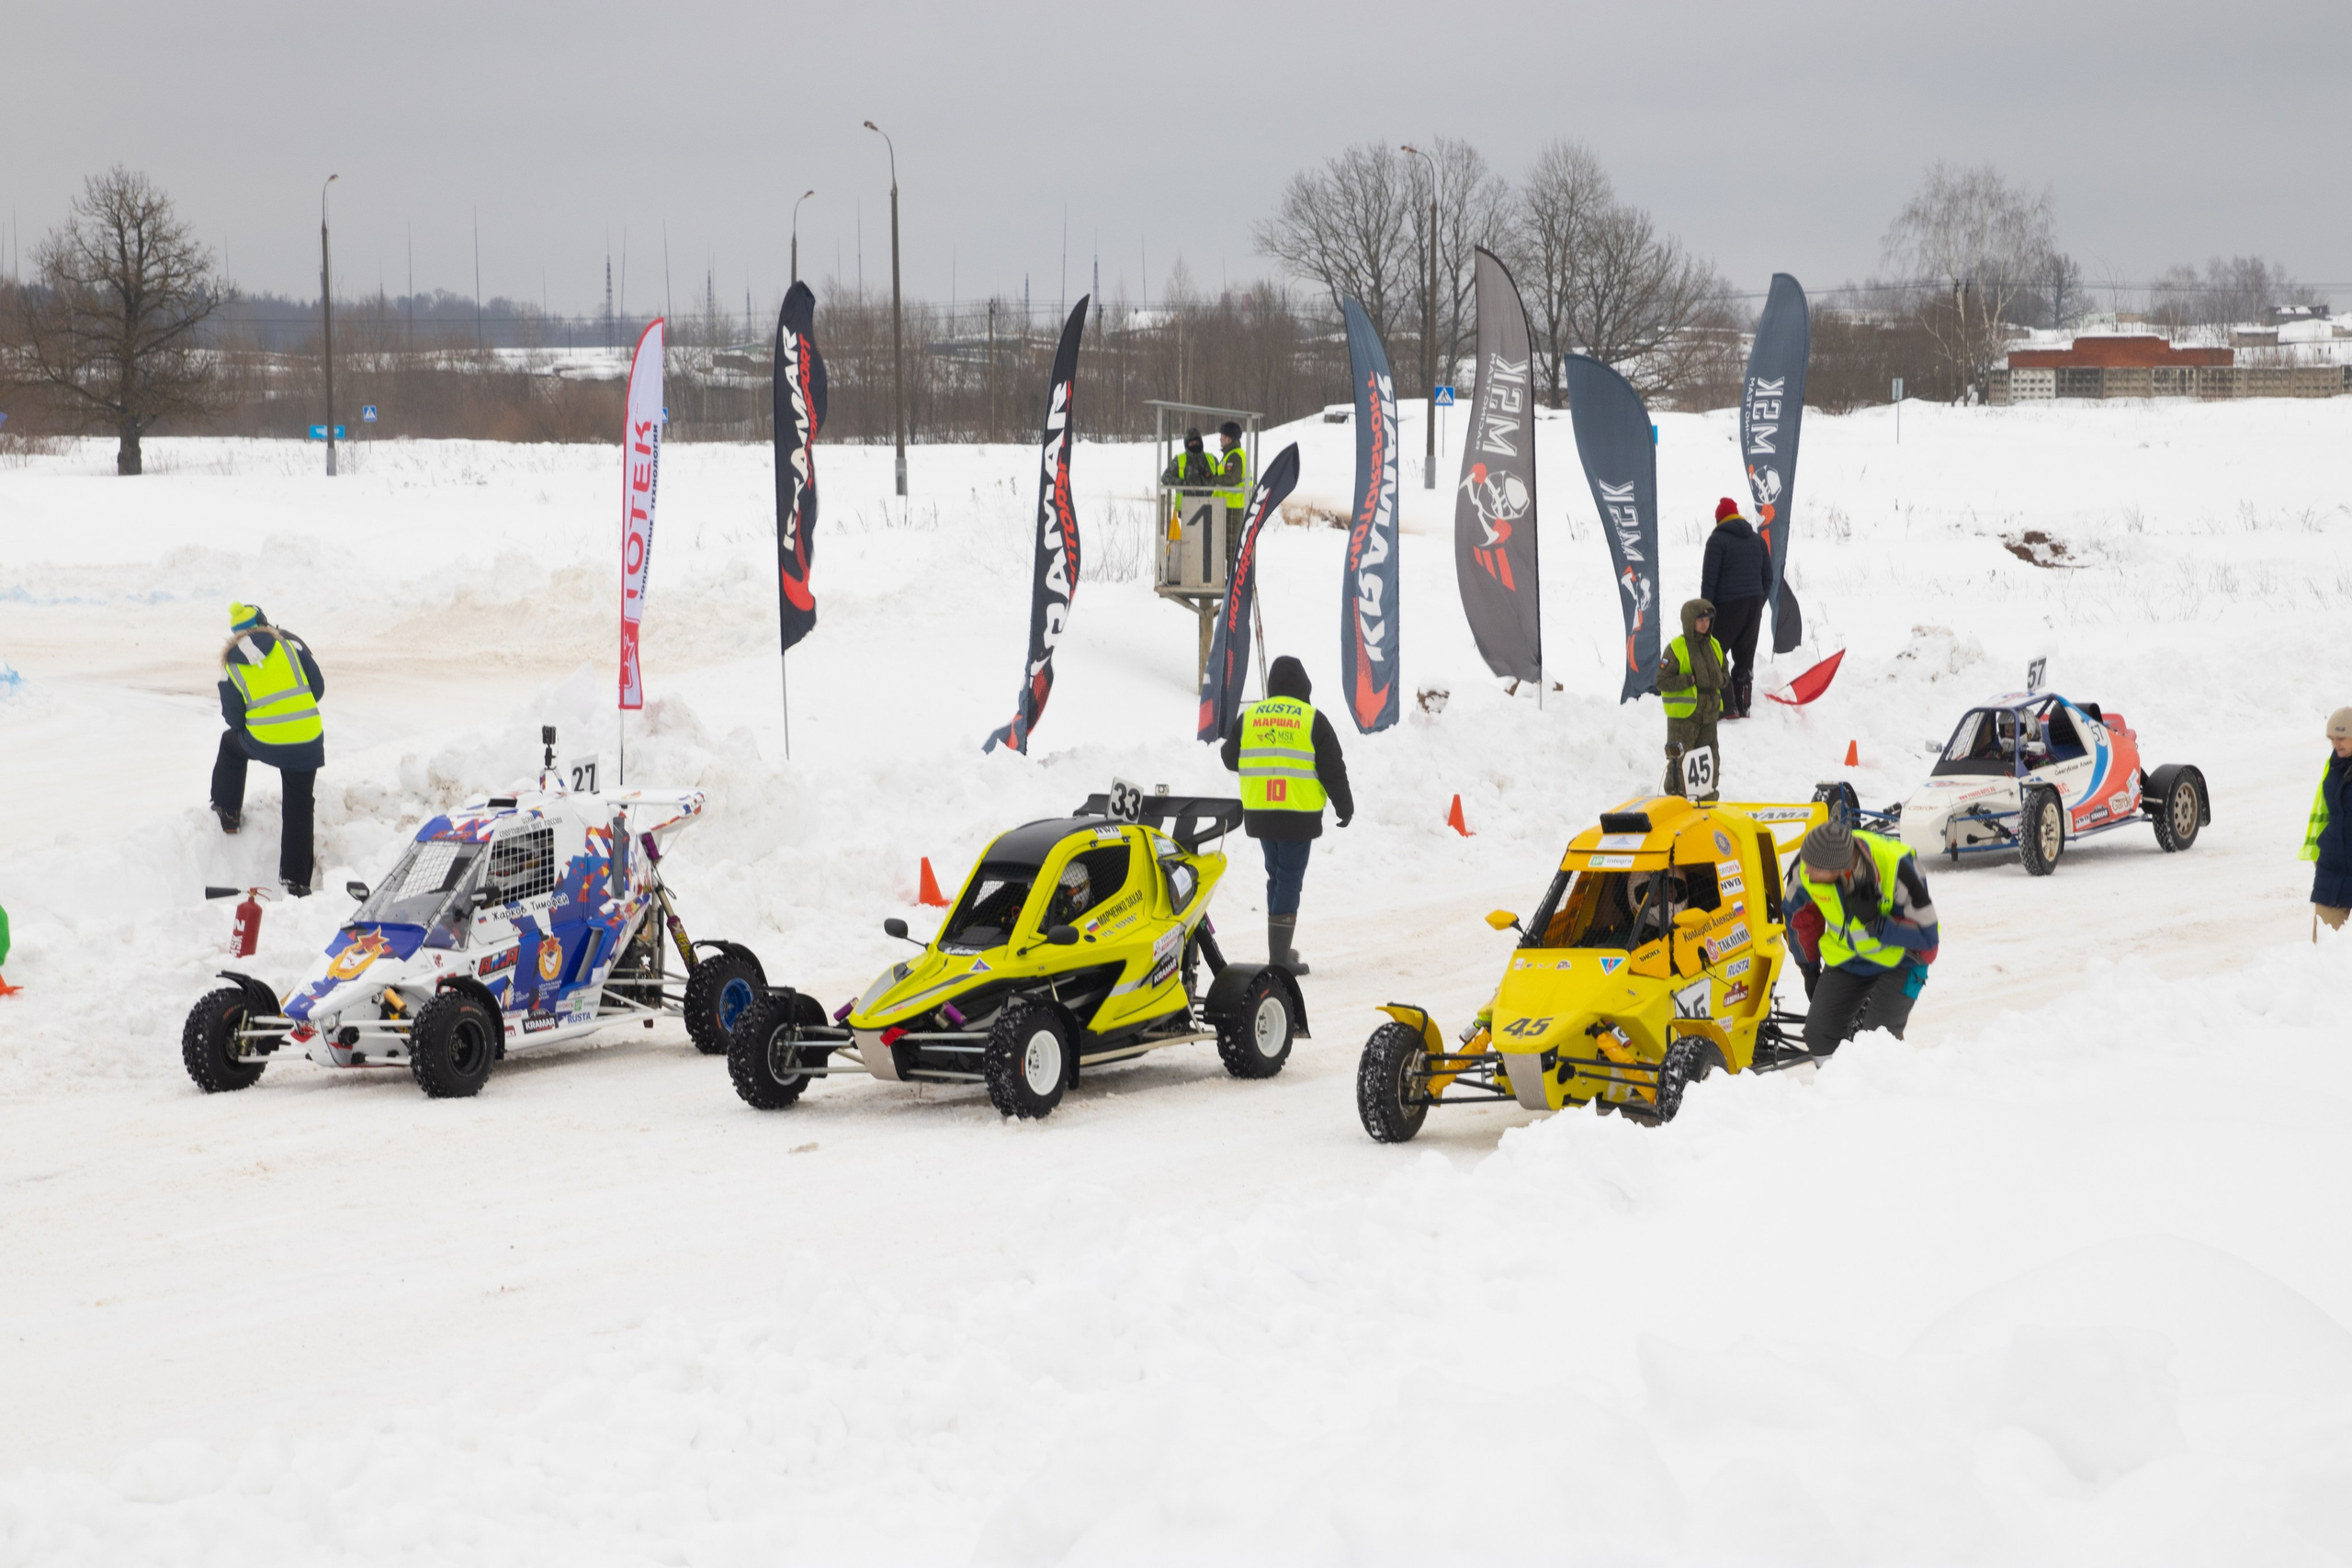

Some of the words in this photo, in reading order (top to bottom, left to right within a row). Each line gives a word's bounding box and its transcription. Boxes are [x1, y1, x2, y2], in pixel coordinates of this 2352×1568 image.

[639, 519, 654, 603] ТОПЛИВНЫЕ
[650, 423, 659, 511] ТЕХНОЛОГИИ
[1186, 503, 1213, 583] 1
[2027, 658, 2047, 689] 57
[1252, 717, 1301, 729] МАРШАЛ
[1255, 704, 1302, 716] RUSTA
[1277, 730, 1295, 741] MSK
[2091, 724, 2104, 742] 57
[571, 762, 596, 792] 27
[1688, 753, 1711, 787] 45
[1112, 783, 1141, 821] 33
[1266, 779, 1286, 802] 10
[492, 903, 527, 922] Жарков
[530, 892, 570, 912] Тимофей
[1096, 899, 1128, 927] МАРЧЕНКО
[1127, 888, 1143, 908] ЗАХАР
[1682, 921, 1713, 942] Комаров
[1712, 908, 1736, 928] Алексей
[1717, 927, 1751, 953] TAKAYAMA
[1153, 958, 1177, 984] KRAMAR
[1727, 958, 1749, 977] RUSTA
[525, 1017, 556, 1031] KRAMAR
[567, 1012, 591, 1024] RUSTA
[1502, 1017, 1555, 1036] 45
